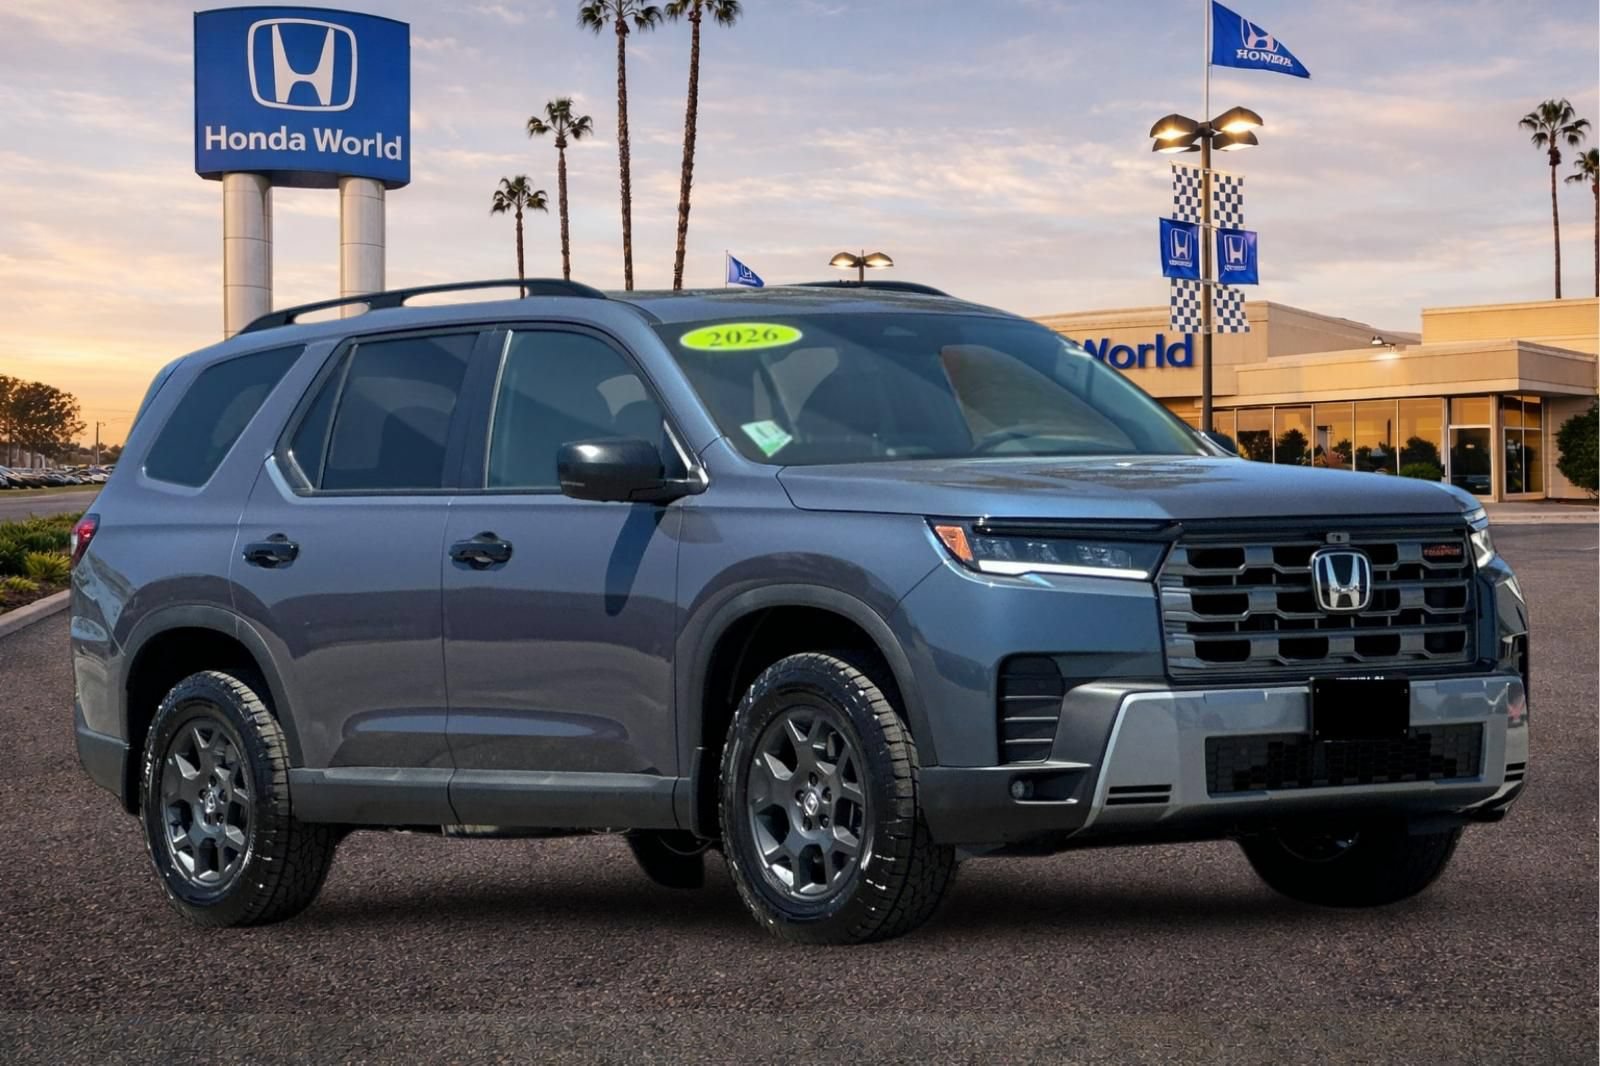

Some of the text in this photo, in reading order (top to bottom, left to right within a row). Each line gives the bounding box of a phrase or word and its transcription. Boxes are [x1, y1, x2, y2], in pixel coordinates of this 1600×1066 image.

[205, 125, 402, 161] Honda World
[706, 328, 779, 347] 2026
